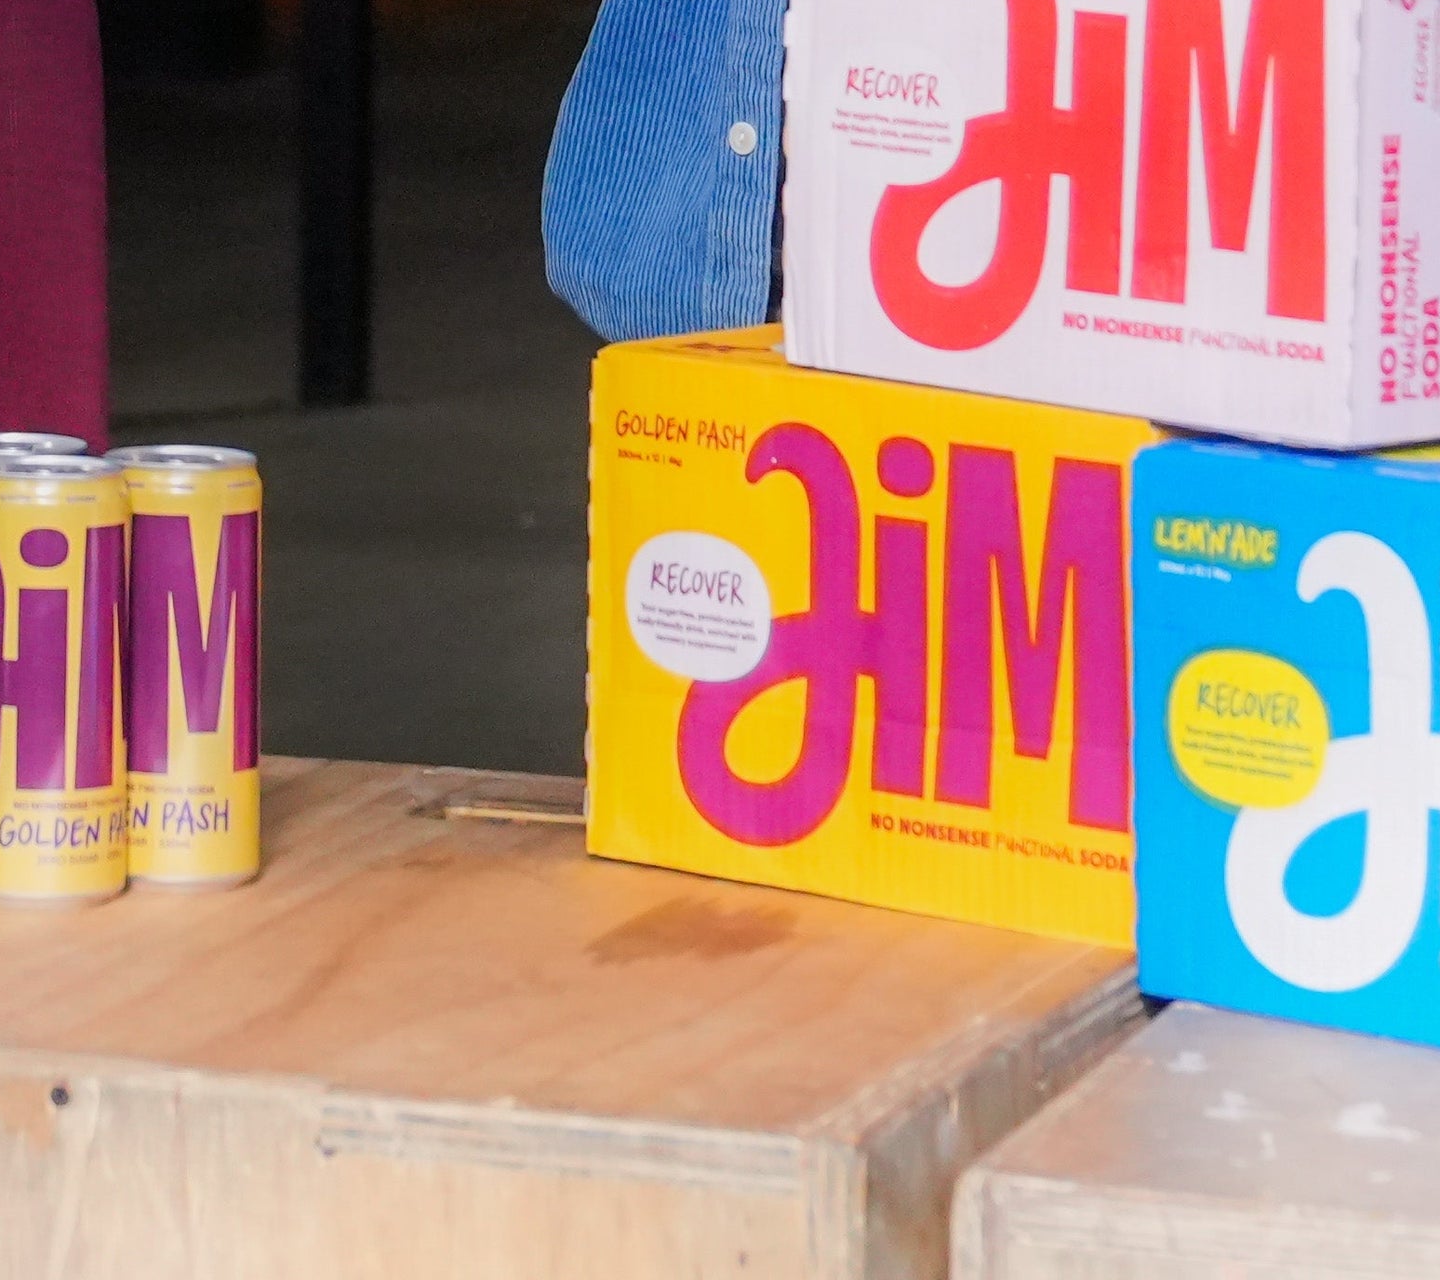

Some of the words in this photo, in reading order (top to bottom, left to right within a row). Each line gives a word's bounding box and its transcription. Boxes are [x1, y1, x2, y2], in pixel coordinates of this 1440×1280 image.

[846, 65, 940, 108] RECOVER
[1380, 135, 1401, 335] NONSENSE
[1063, 311, 1087, 330] NO
[1093, 316, 1183, 343] NONSENSE
[1276, 340, 1326, 362] SODA
[1423, 297, 1440, 400] SODA
[1380, 347, 1398, 403] NO
[615, 409, 689, 443] GOLDEN
[697, 419, 746, 453] PASH
[1155, 516, 1277, 564] LEM'N'ADE
[650, 560, 744, 606] RECOVER
[1197, 682, 1301, 729] RECOVER
[162, 799, 230, 835] PASH
[871, 813, 894, 831] NO
[899, 816, 990, 848] NONSENSE
[1080, 848, 1129, 872] SODA
